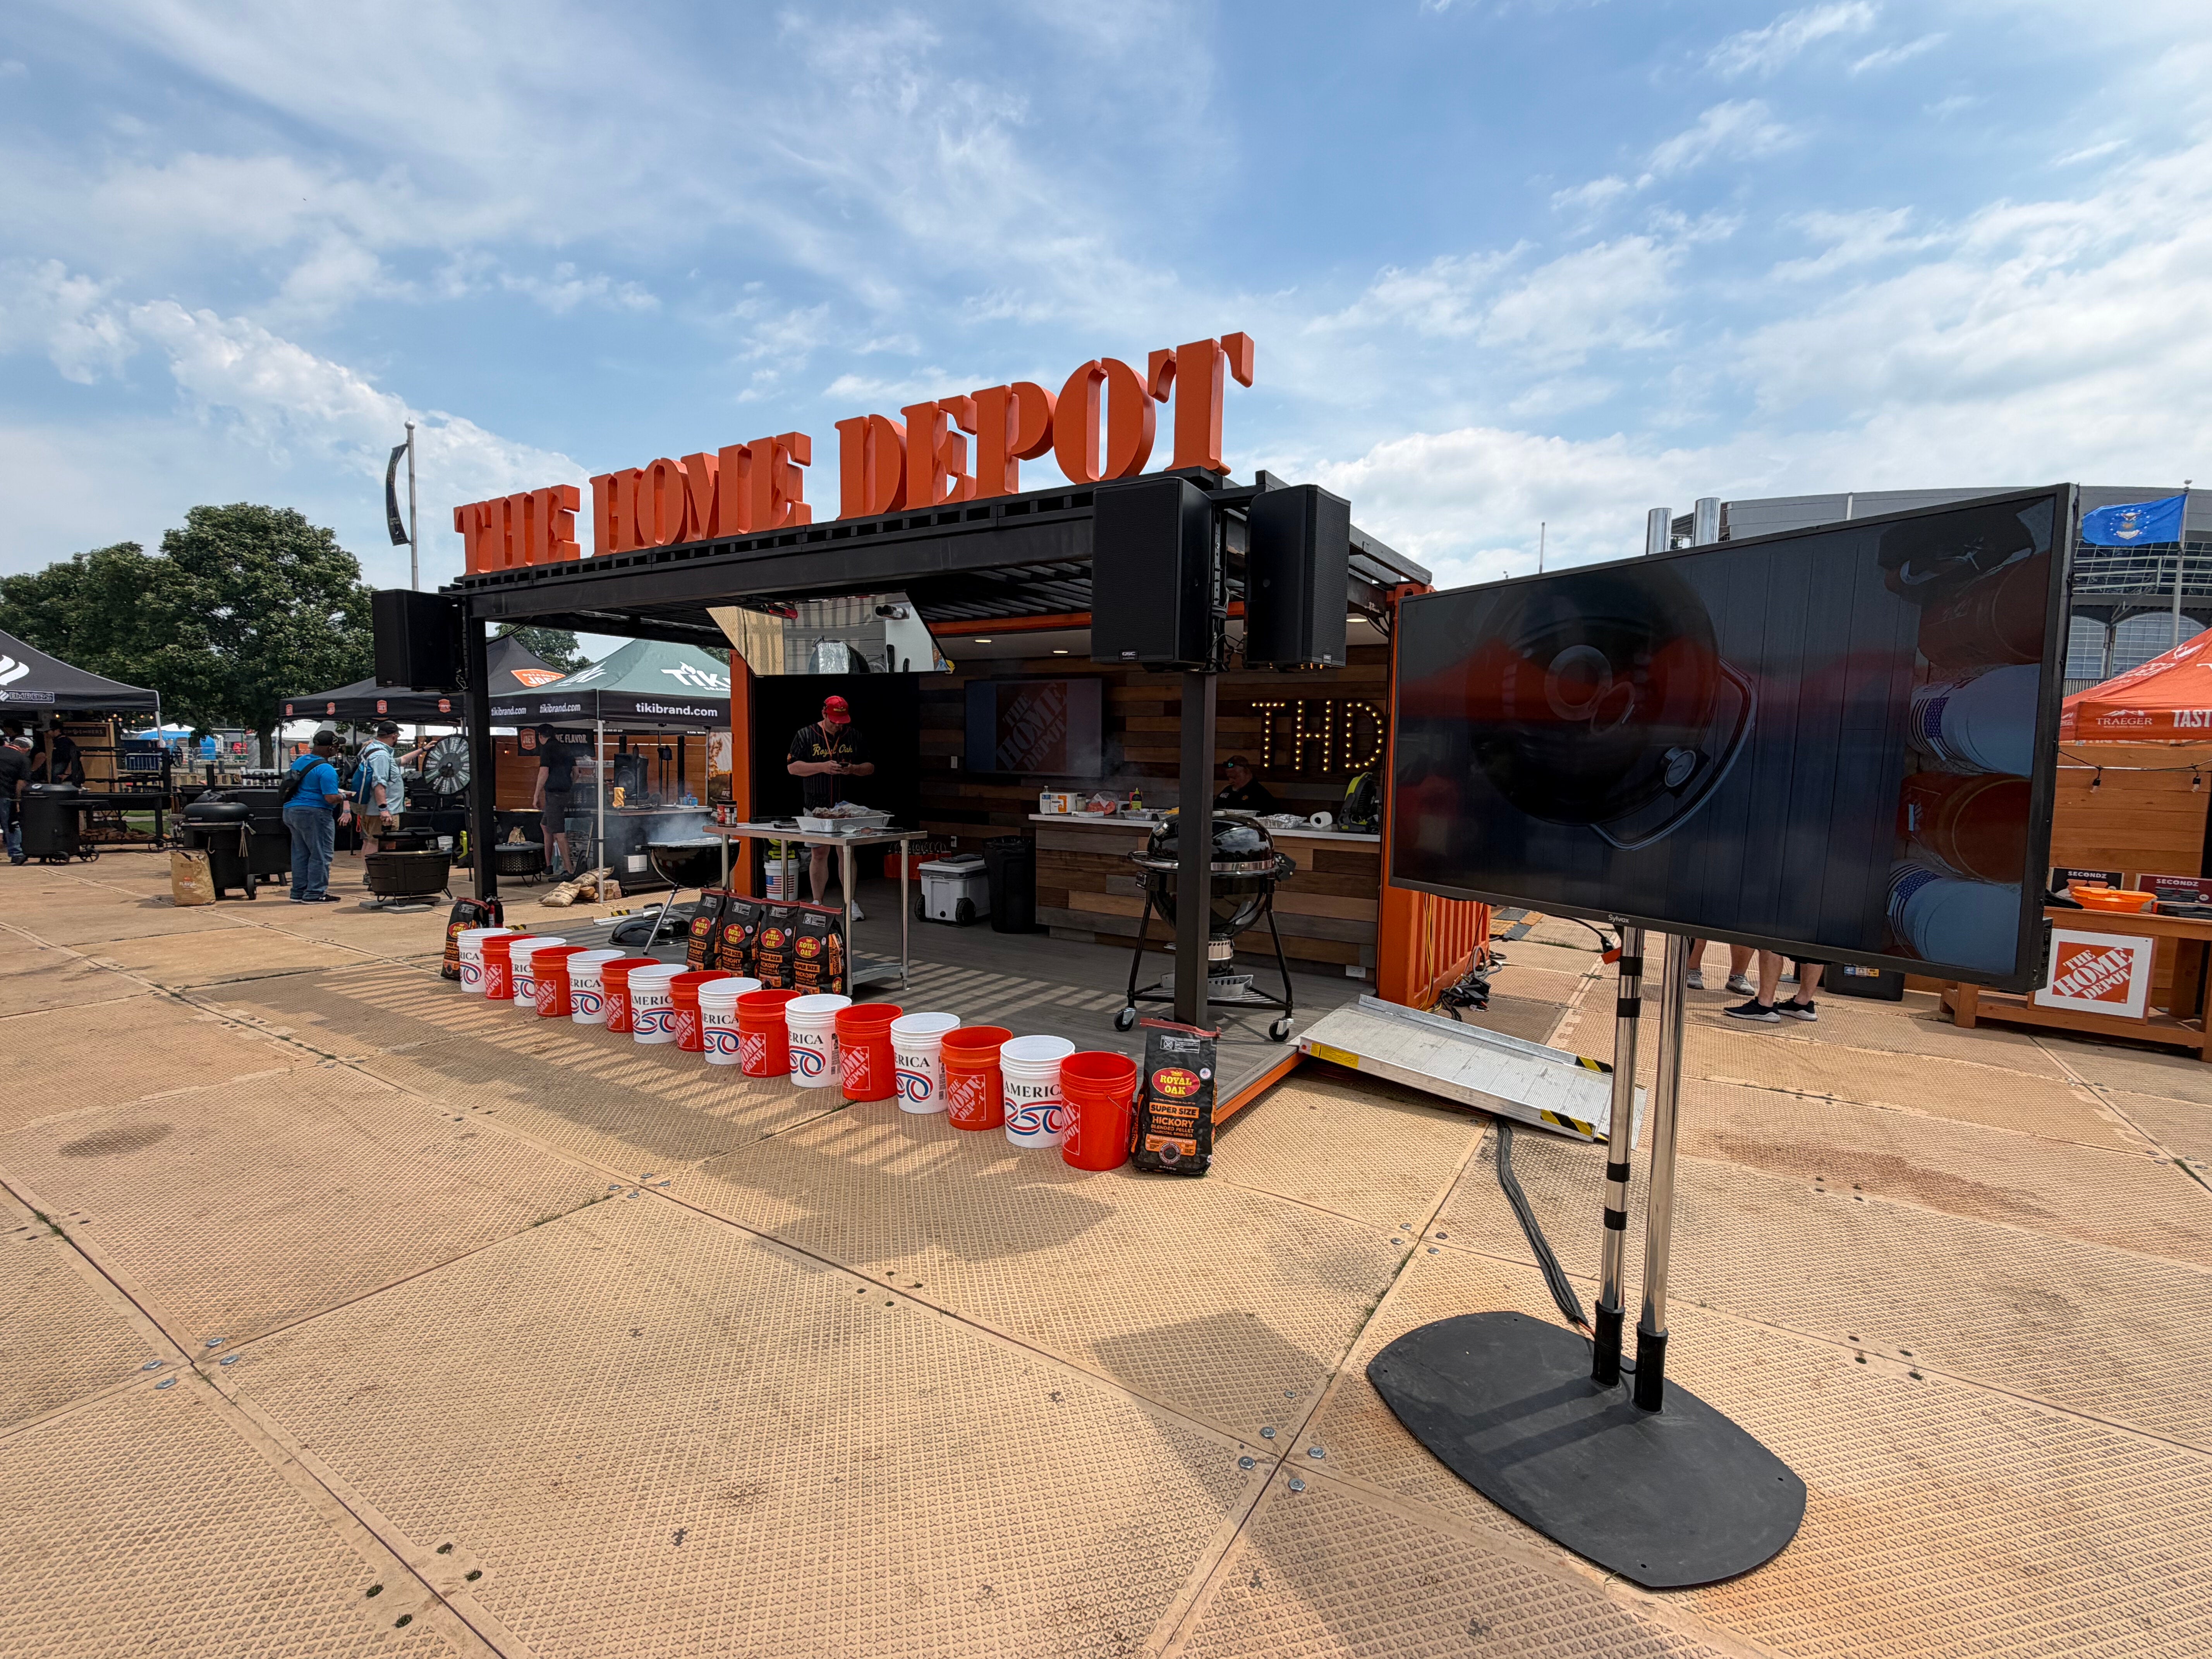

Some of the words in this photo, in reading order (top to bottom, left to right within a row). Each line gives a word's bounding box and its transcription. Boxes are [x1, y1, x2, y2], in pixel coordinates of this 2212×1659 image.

[453, 484, 580, 576] THE
[589, 431, 812, 556] HOME
[834, 331, 1254, 520] DEPOT
[9, 692, 53, 701] EMBERS
[491, 706, 527, 716] tikibrand.com
[539, 702, 581, 713] tikibrand.com
[635, 702, 718, 717] tikibrand.com
[1002, 692, 1032, 728] THE
[996, 682, 1065, 771] HOME
[1024, 716, 1066, 771] DEPOT
[1250, 699, 1385, 772] THD
[812, 743, 836, 757] Royal
[839, 744, 853, 753] Oak
[1608, 914, 1630, 923] Sylvox
[799, 941, 816, 950] ROYAL
[460, 952, 479, 960] RICA
[2063, 950, 2096, 970] THE
[2053, 947, 2133, 997] HOME
[570, 978, 601, 988] ERICA
[2081, 969, 2131, 1000] DEPOT
[702, 1012, 739, 1024] ERICA
[789, 1030, 824, 1044] ERICA
[740, 1034, 765, 1063] OME
[744, 1048, 766, 1072] DEPOT
[841, 1047, 869, 1079] OME
[895, 1052, 931, 1068] ERICA
[845, 1063, 869, 1088] DEPOT
[1160, 1075, 1192, 1086] ROYAL
[948, 1079, 962, 1095] THE
[1004, 1080, 1062, 1098] AMERIC
[1164, 1085, 1186, 1095] OAK
[949, 1075, 985, 1118] HOME
[1151, 1104, 1177, 1114] SUPER
[1152, 1116, 1194, 1128] HICKORY
